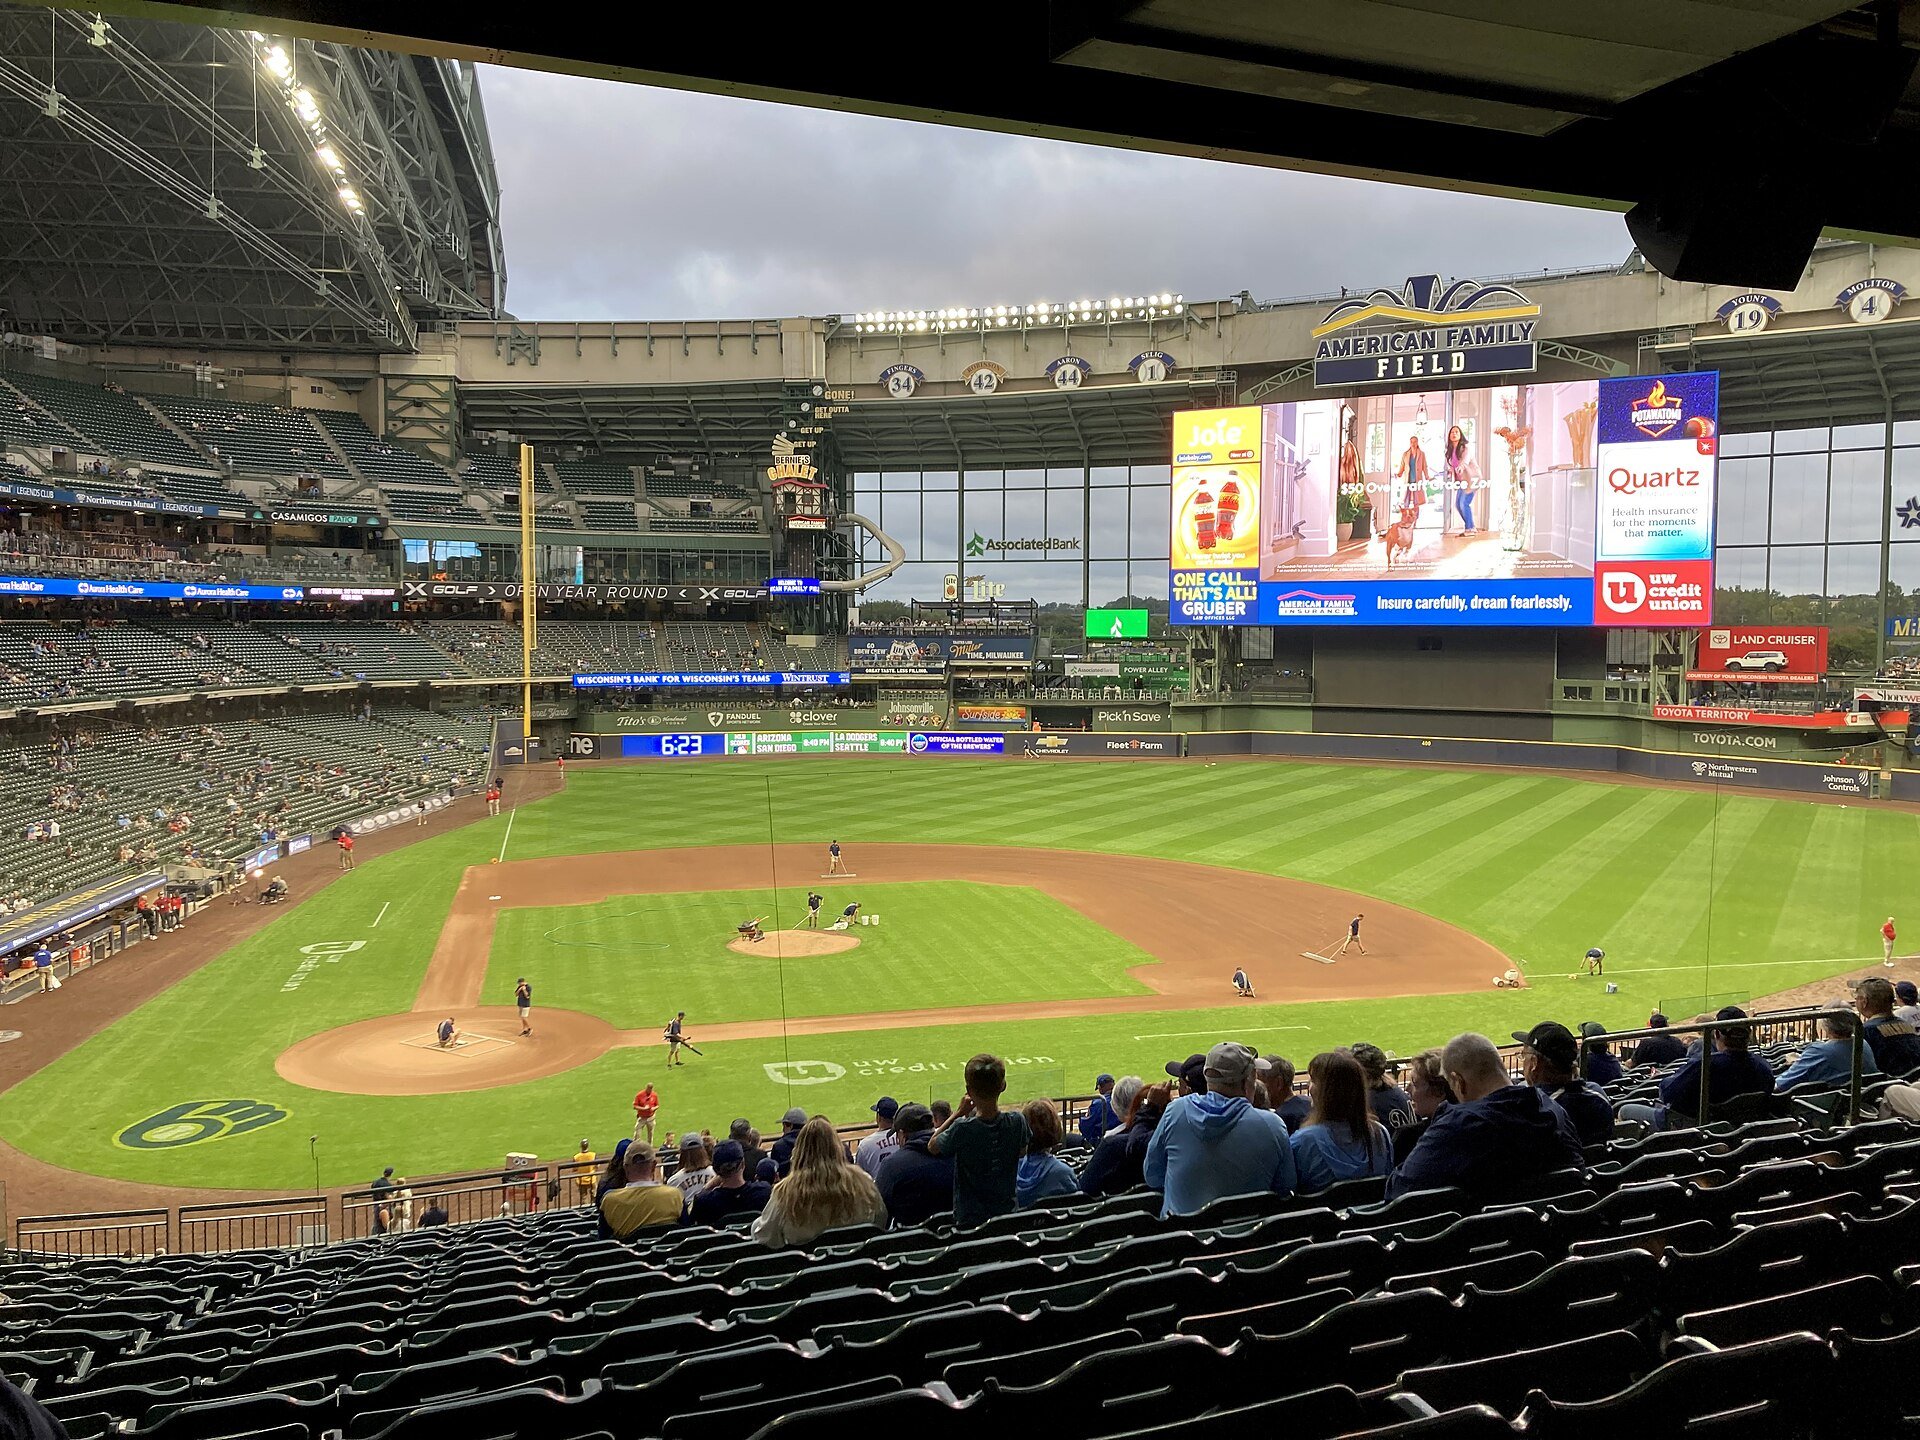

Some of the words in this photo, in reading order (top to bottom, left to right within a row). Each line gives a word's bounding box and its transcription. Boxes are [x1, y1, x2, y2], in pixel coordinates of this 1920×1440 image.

[1846, 279, 1897, 296] MOLITOR
[1731, 294, 1768, 307] YOUNT
[1861, 295, 1878, 316] 4
[1734, 309, 1764, 331] 19
[1316, 330, 1437, 360] AMERICAN
[1446, 320, 1539, 348] FAMILY
[1056, 357, 1081, 366] AARON
[1377, 351, 1466, 378] FIELD
[886, 365, 918, 375] FINGERS
[1147, 365, 1158, 381] 1
[973, 375, 993, 389] 42
[1057, 369, 1079, 385] 44
[891, 377, 912, 392] 34
[824, 390, 855, 400] GONE!
[1631, 408, 1682, 423] POTAWATOMI
[1188, 417, 1243, 447] Joie
[775, 455, 810, 465] BERNIE'S
[767, 464, 818, 481] CHALET
[1340, 482, 1364, 495] $50
[1429, 479, 1468, 491] Grace
[1608, 467, 1700, 495] Quartz
[16, 486, 40, 497] LEGENDS
[40, 489, 54, 499] CLUB
[86, 495, 132, 507] Northwestern
[133, 500, 156, 509] Mutual
[162, 502, 188, 512] LEGENDS
[188, 505, 204, 514] CLUB
[271, 511, 328, 523] CASAMIGOS
[1612, 507, 1645, 517] Health
[1648, 506, 1698, 516] insurance
[1613, 518, 1626, 527] for
[1629, 518, 1646, 527] the
[1648, 517, 1696, 527] moments
[1624, 529, 1644, 538] that
[1648, 528, 1684, 537] matter.
[1173, 572, 1206, 587] ONE
[1649, 573, 1678, 585] uw
[10, 580, 30, 591] Health
[30, 582, 44, 592] Care
[105, 585, 127, 594] Health
[128, 585, 144, 595] Care
[216, 588, 235, 597] Health
[235, 588, 249, 597] Care
[432, 585, 478, 595] GOLF
[556, 586, 598, 598] YEAR
[606, 586, 669, 599] ROUND
[723, 589, 768, 599] GOLF
[972, 580, 1006, 602] Lite
[1648, 583, 1702, 597] credit
[1172, 587, 1223, 602] THAT'S
[1225, 586, 1258, 601] ALL!
[1181, 601, 1246, 616] GRUBER
[1278, 599, 1323, 608] AMERICAN
[1324, 598, 1355, 608] FAMILY
[1377, 595, 1413, 610] Insure
[1415, 594, 1468, 612] carefully,
[1470, 595, 1508, 610] dream
[1510, 594, 1573, 612] fearlessly.
[1648, 596, 1703, 611] union
[1733, 635, 1765, 645] LAND
[1767, 635, 1816, 646] CRUISER
[950, 643, 983, 658] Miller
[967, 652, 985, 660] TIME,
[985, 651, 1024, 659] MILWAUKEE
[1124, 666, 1147, 674] POWER
[1148, 666, 1168, 674] ALLEY
[577, 676, 632, 684] WISCONSIN'S
[634, 675, 658, 684] BANK
[662, 675, 680, 683] FOR
[681, 674, 740, 683] WISCONSIN'S
[742, 674, 771, 683] TEAMS
[782, 673, 829, 683] WINTRUST
[888, 701, 934, 714] Johnsonville
[1656, 707, 1694, 718] TOYOTA
[1694, 709, 1751, 721] TERRITORY
[802, 710, 838, 722] clover
[961, 708, 1001, 721] Surfside
[1132, 711, 1161, 722] Save
[616, 716, 647, 727] Tito's
[661, 735, 702, 755] 6:23
[757, 733, 792, 743] ARIZONA
[803, 738, 820, 747] 8:40
[820, 738, 830, 746] PM
[835, 733, 846, 741] LA
[846, 733, 878, 742] DODGERS
[880, 738, 896, 747] 8:40
[928, 736, 955, 744] OFFICIAL
[955, 736, 981, 744] BOTTLED
[1106, 741, 1129, 749] Fleet
[1140, 741, 1163, 750] Farm
[1692, 732, 1777, 748] TOYOTA.COM
[756, 744, 773, 753] SAN
[774, 743, 797, 753] DIEGO
[834, 742, 869, 752] SEATTLE
[1708, 763, 1758, 774] Northwestern
[1708, 769, 1734, 779] Mutual
[1823, 774, 1855, 784] Johnson
[1828, 783, 1860, 792] Controls
[858, 1061, 950, 1076] credit
